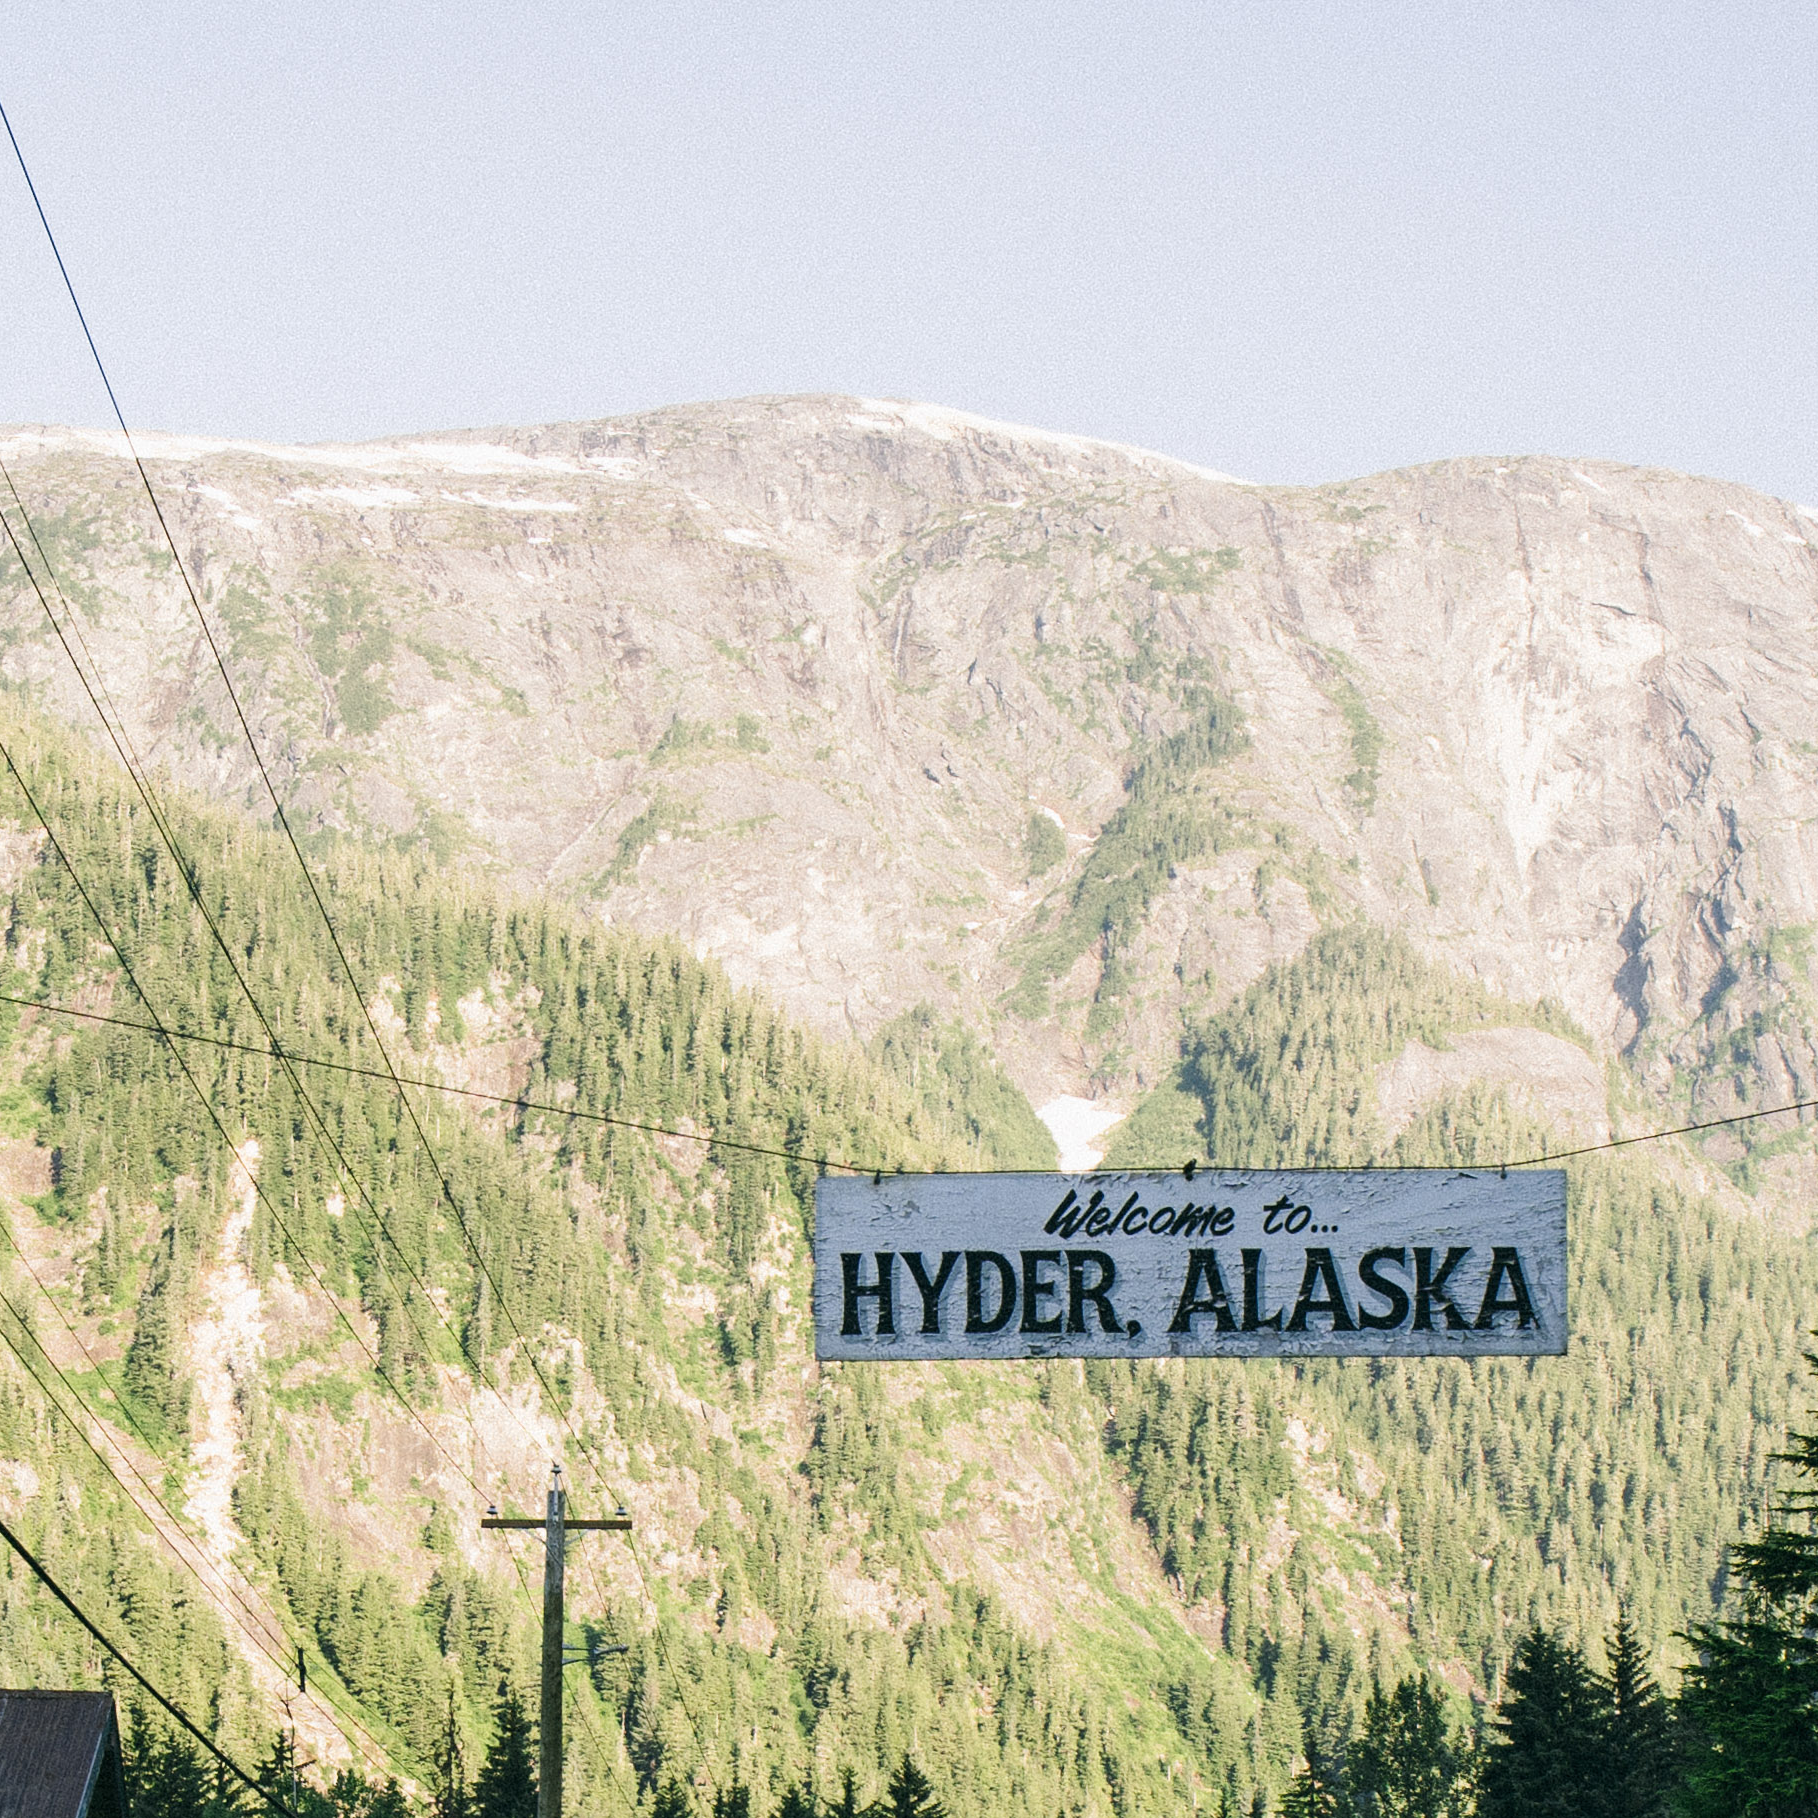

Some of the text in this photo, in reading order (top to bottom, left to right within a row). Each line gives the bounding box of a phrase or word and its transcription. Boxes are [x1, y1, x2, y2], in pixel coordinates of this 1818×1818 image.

[1043, 1188, 1339, 1239] Welcome to...
[839, 1246, 1542, 1338] HYDER, ALASKA
